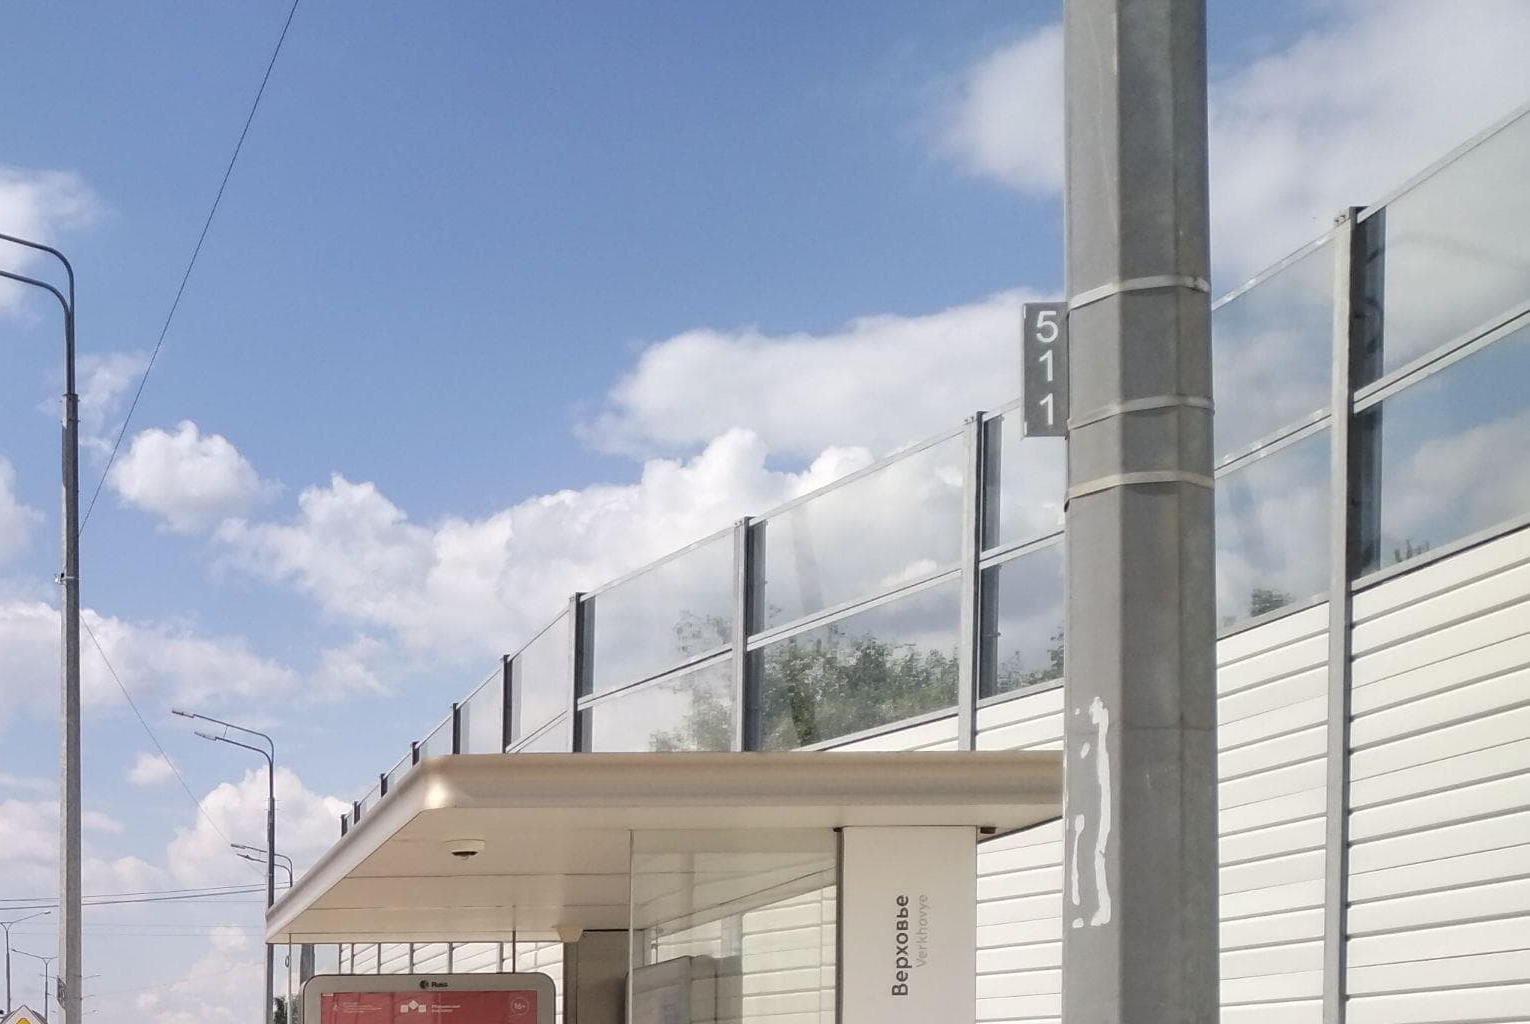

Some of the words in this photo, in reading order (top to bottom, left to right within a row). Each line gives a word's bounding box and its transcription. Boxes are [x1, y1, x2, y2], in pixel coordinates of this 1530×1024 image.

[1036, 311, 1059, 425] 511
[892, 895, 912, 996] Верховье
[916, 894, 931, 968] Verkhovye
